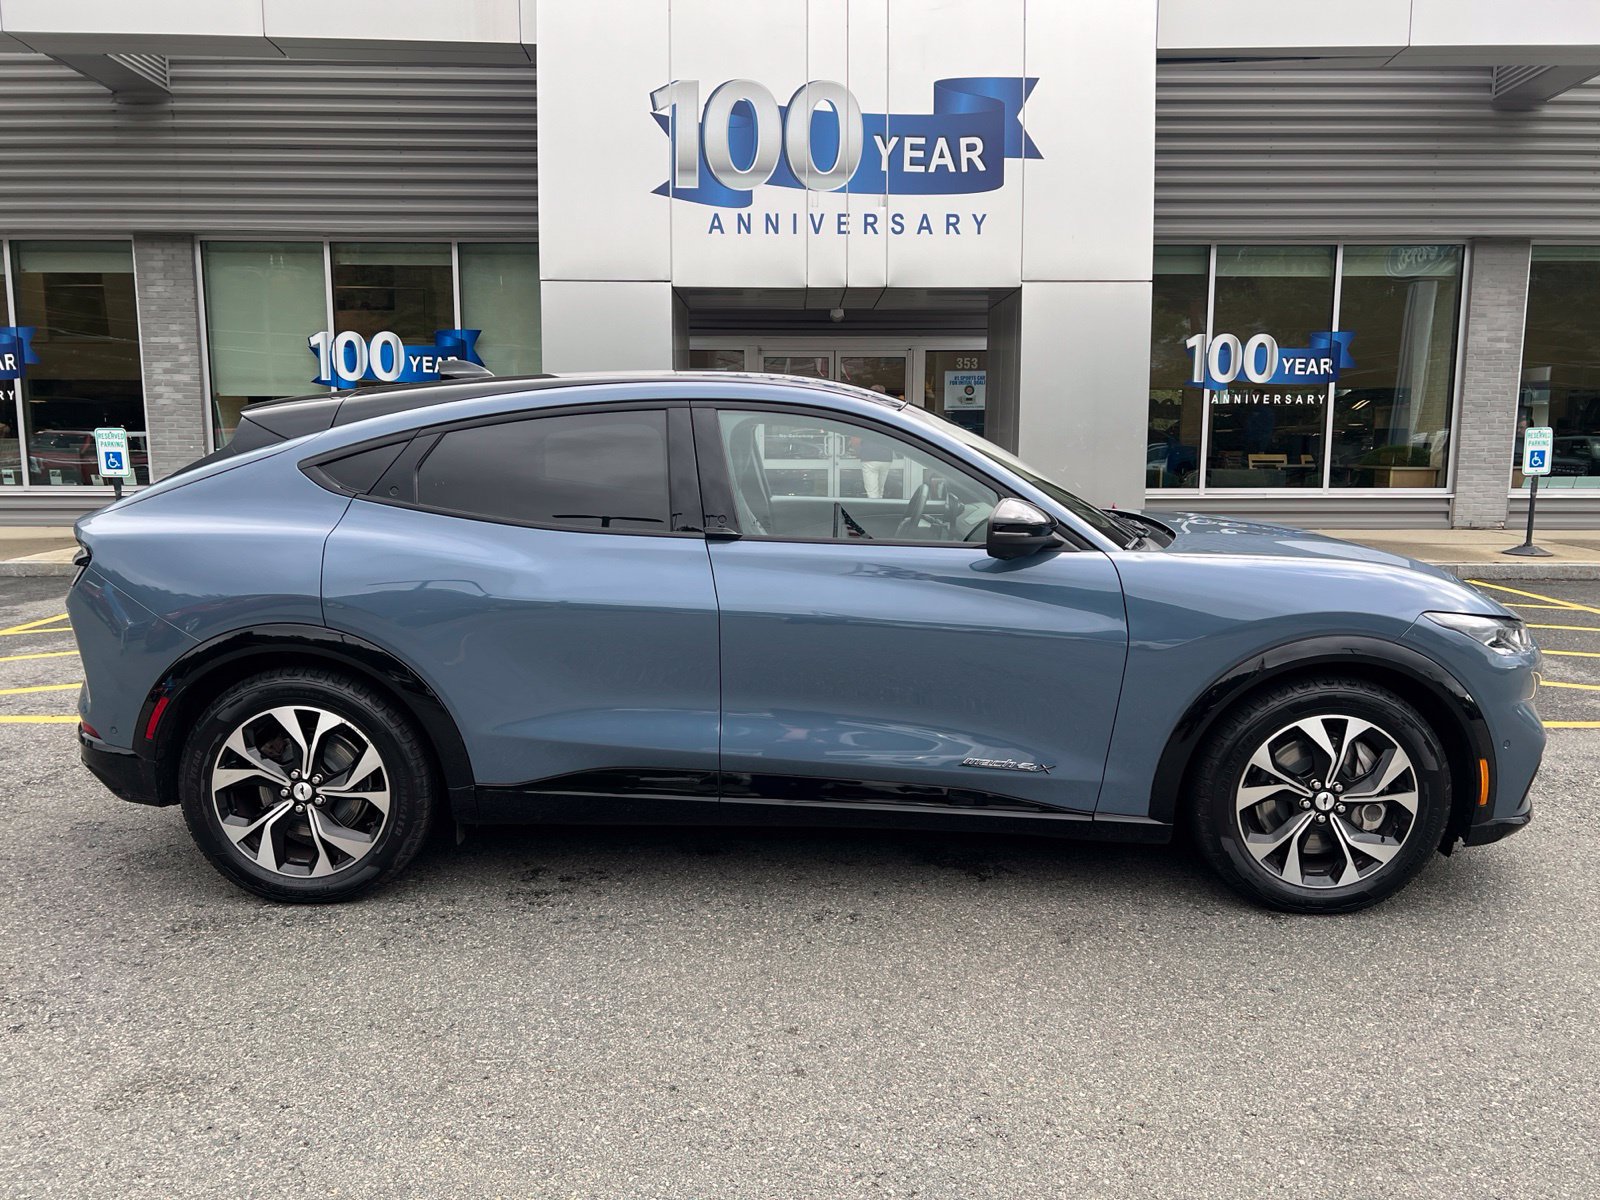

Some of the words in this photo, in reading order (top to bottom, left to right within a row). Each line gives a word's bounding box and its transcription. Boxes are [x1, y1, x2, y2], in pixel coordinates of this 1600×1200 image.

[650, 79, 863, 191] 100
[873, 135, 987, 173] YEAR
[708, 213, 987, 236] ANNIVERSARY
[308, 330, 405, 382] 100
[409, 356, 459, 374] YEA
[956, 357, 978, 369] 353
[1185, 333, 1279, 384] 100
[1282, 357, 1333, 375] YEAR
[1211, 394, 1326, 404] ANNIVERSARY
[97, 432, 125, 440] RESERVED
[100, 440, 124, 448] PARKING
